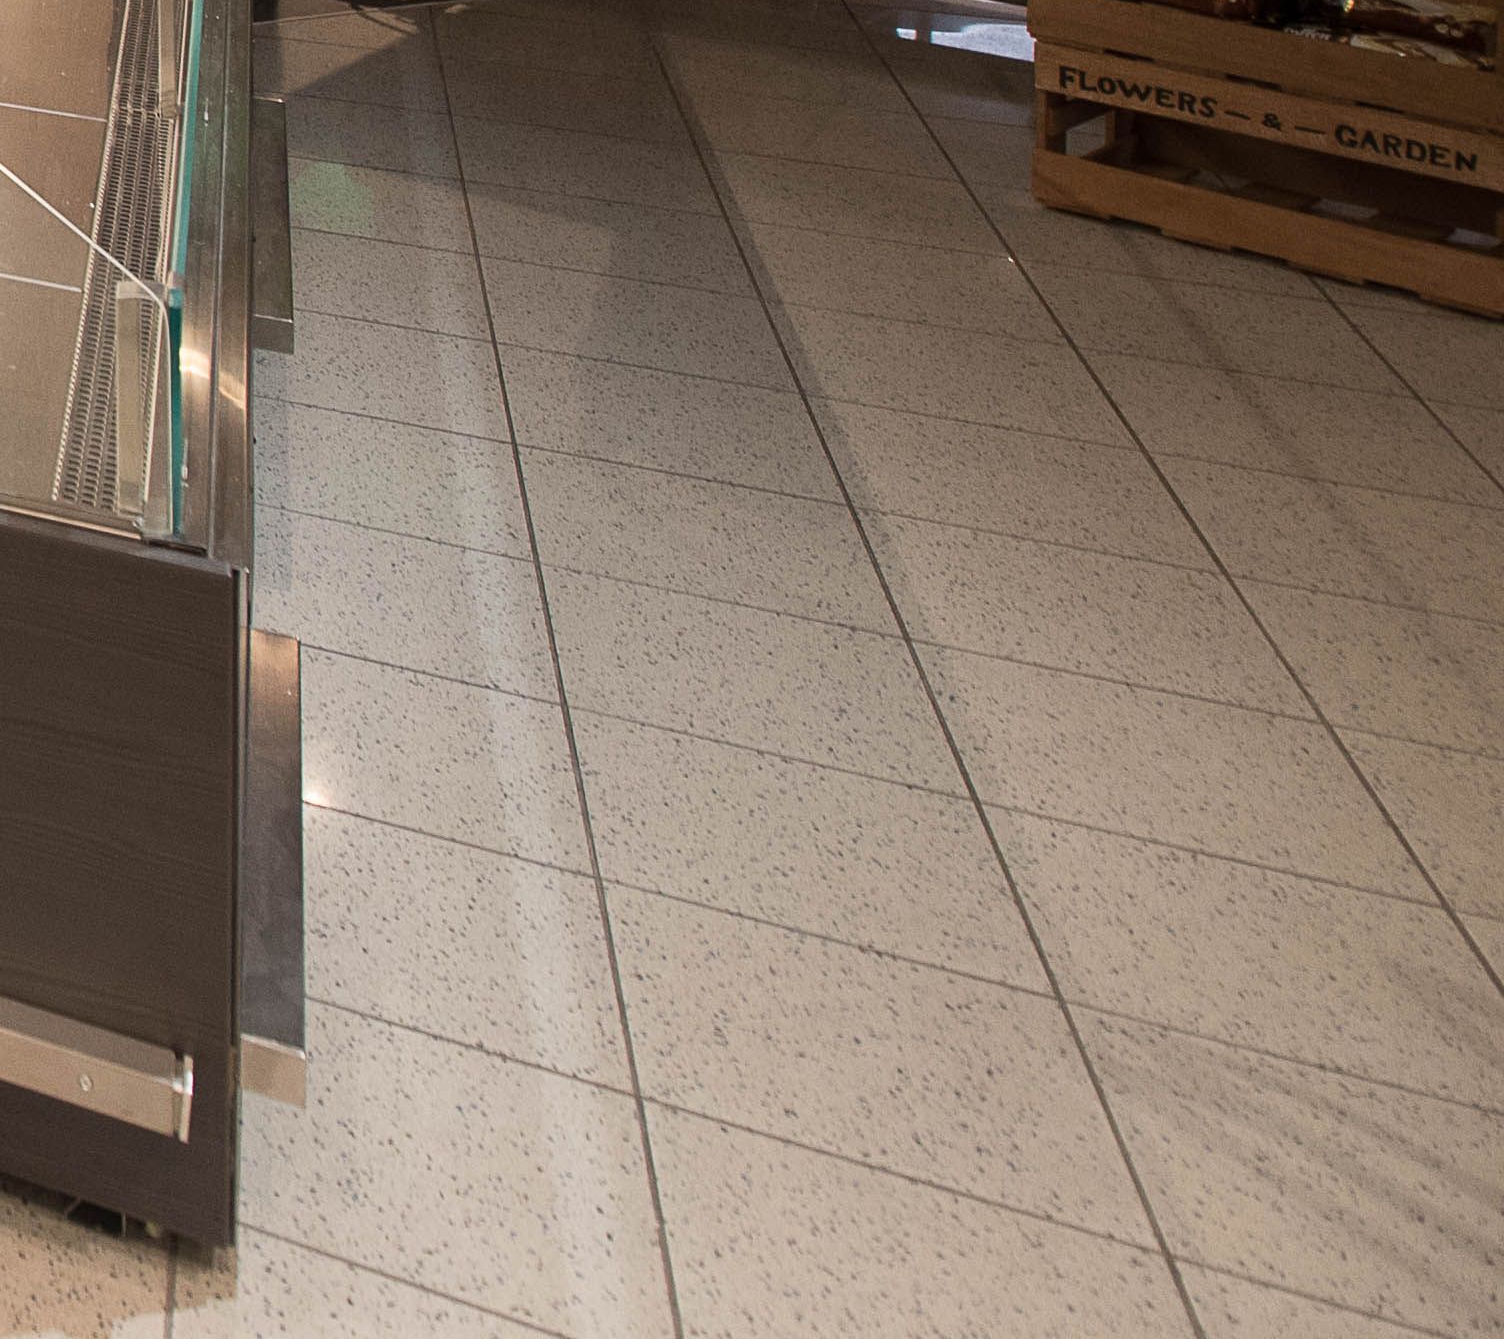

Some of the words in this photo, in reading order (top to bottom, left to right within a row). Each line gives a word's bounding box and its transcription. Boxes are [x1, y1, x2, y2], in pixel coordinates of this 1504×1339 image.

[1058, 65, 1218, 120] FLOWERS
[1262, 111, 1282, 130] &
[1334, 123, 1478, 173] GARDEN
